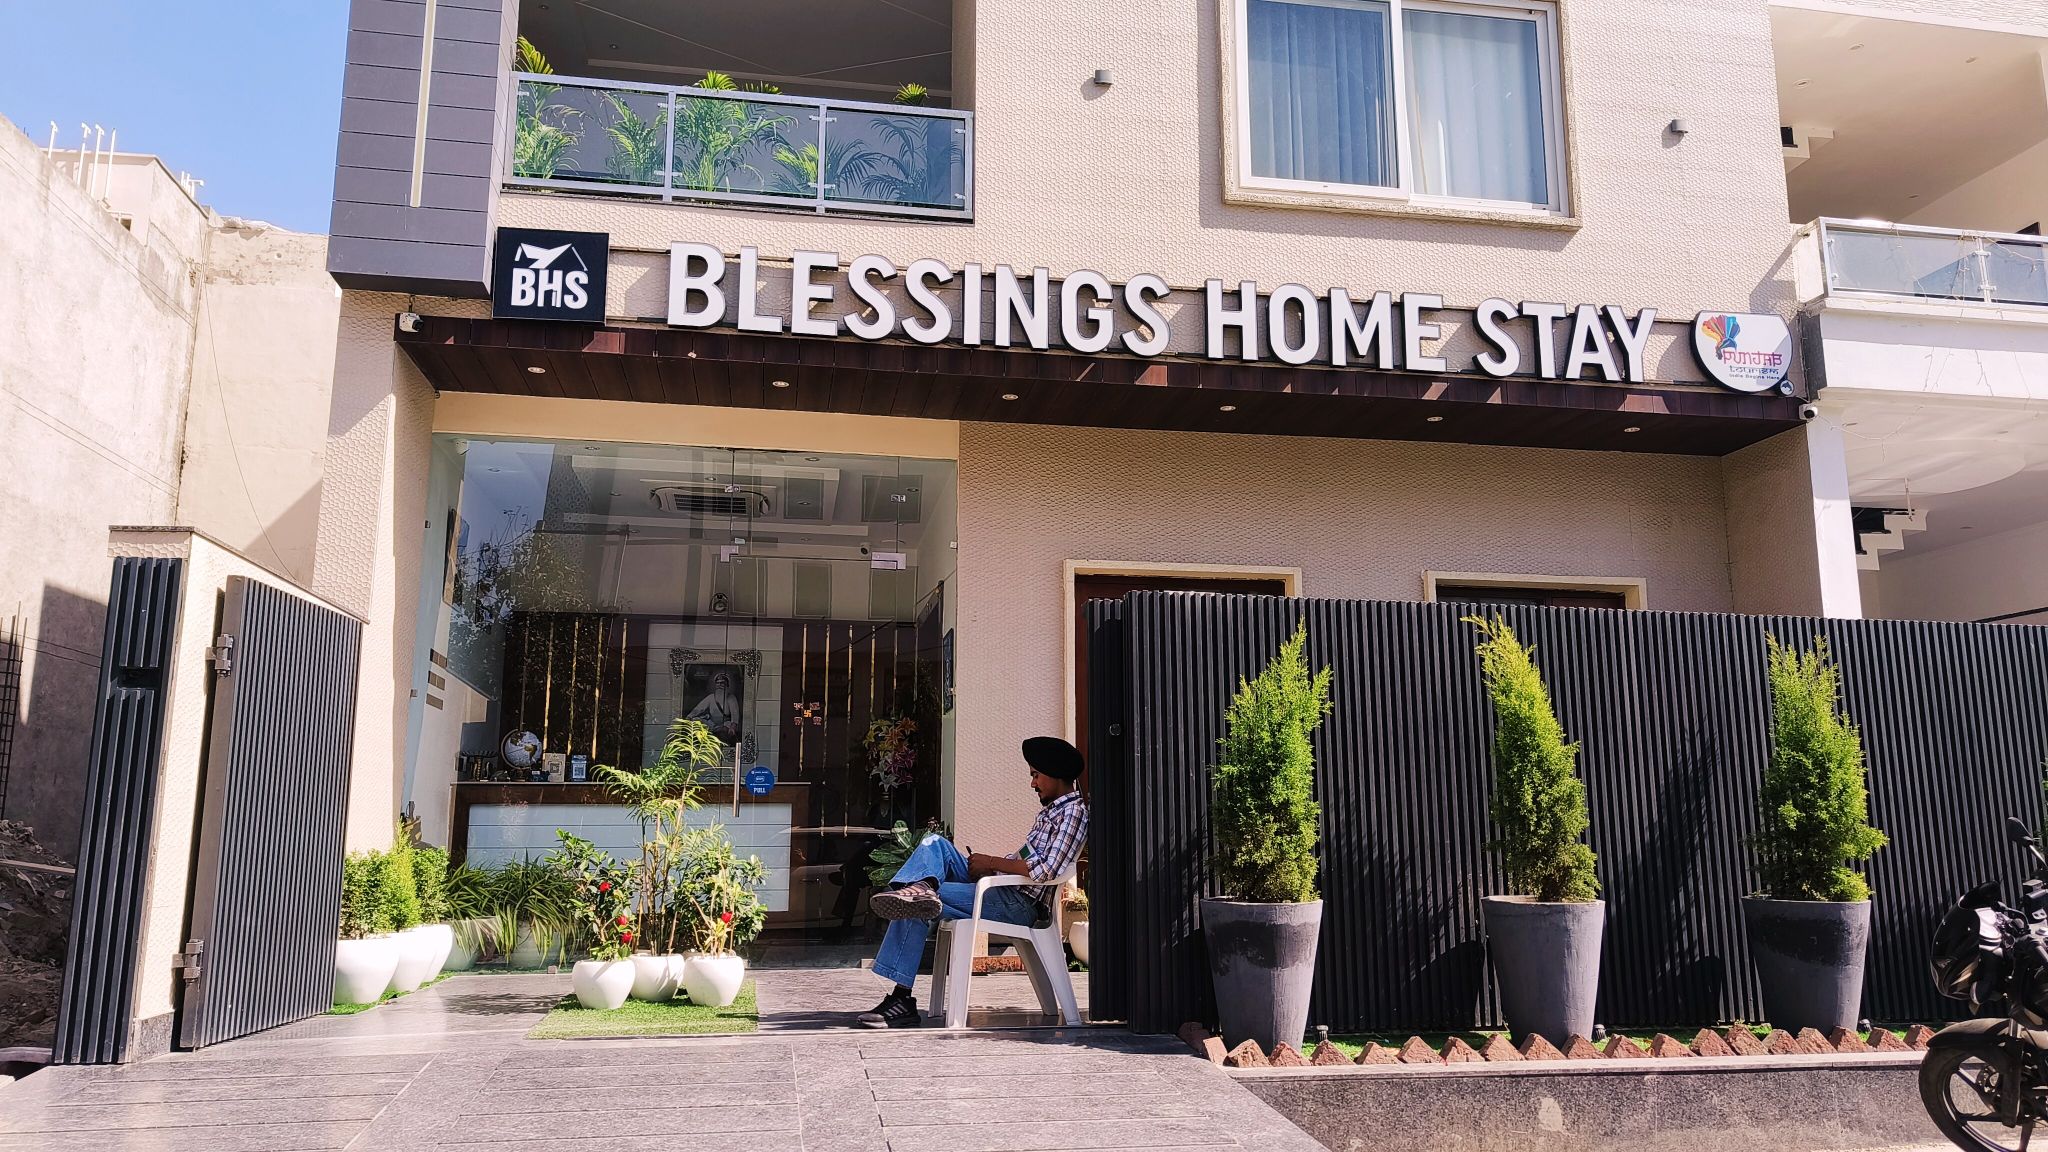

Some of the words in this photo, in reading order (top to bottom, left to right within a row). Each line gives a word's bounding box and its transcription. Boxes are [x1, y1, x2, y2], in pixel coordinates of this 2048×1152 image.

[511, 268, 589, 309] BHS
[667, 240, 1172, 357] BLESSINGS
[1204, 278, 1448, 372] HOME
[1472, 297, 1658, 383] STAY
